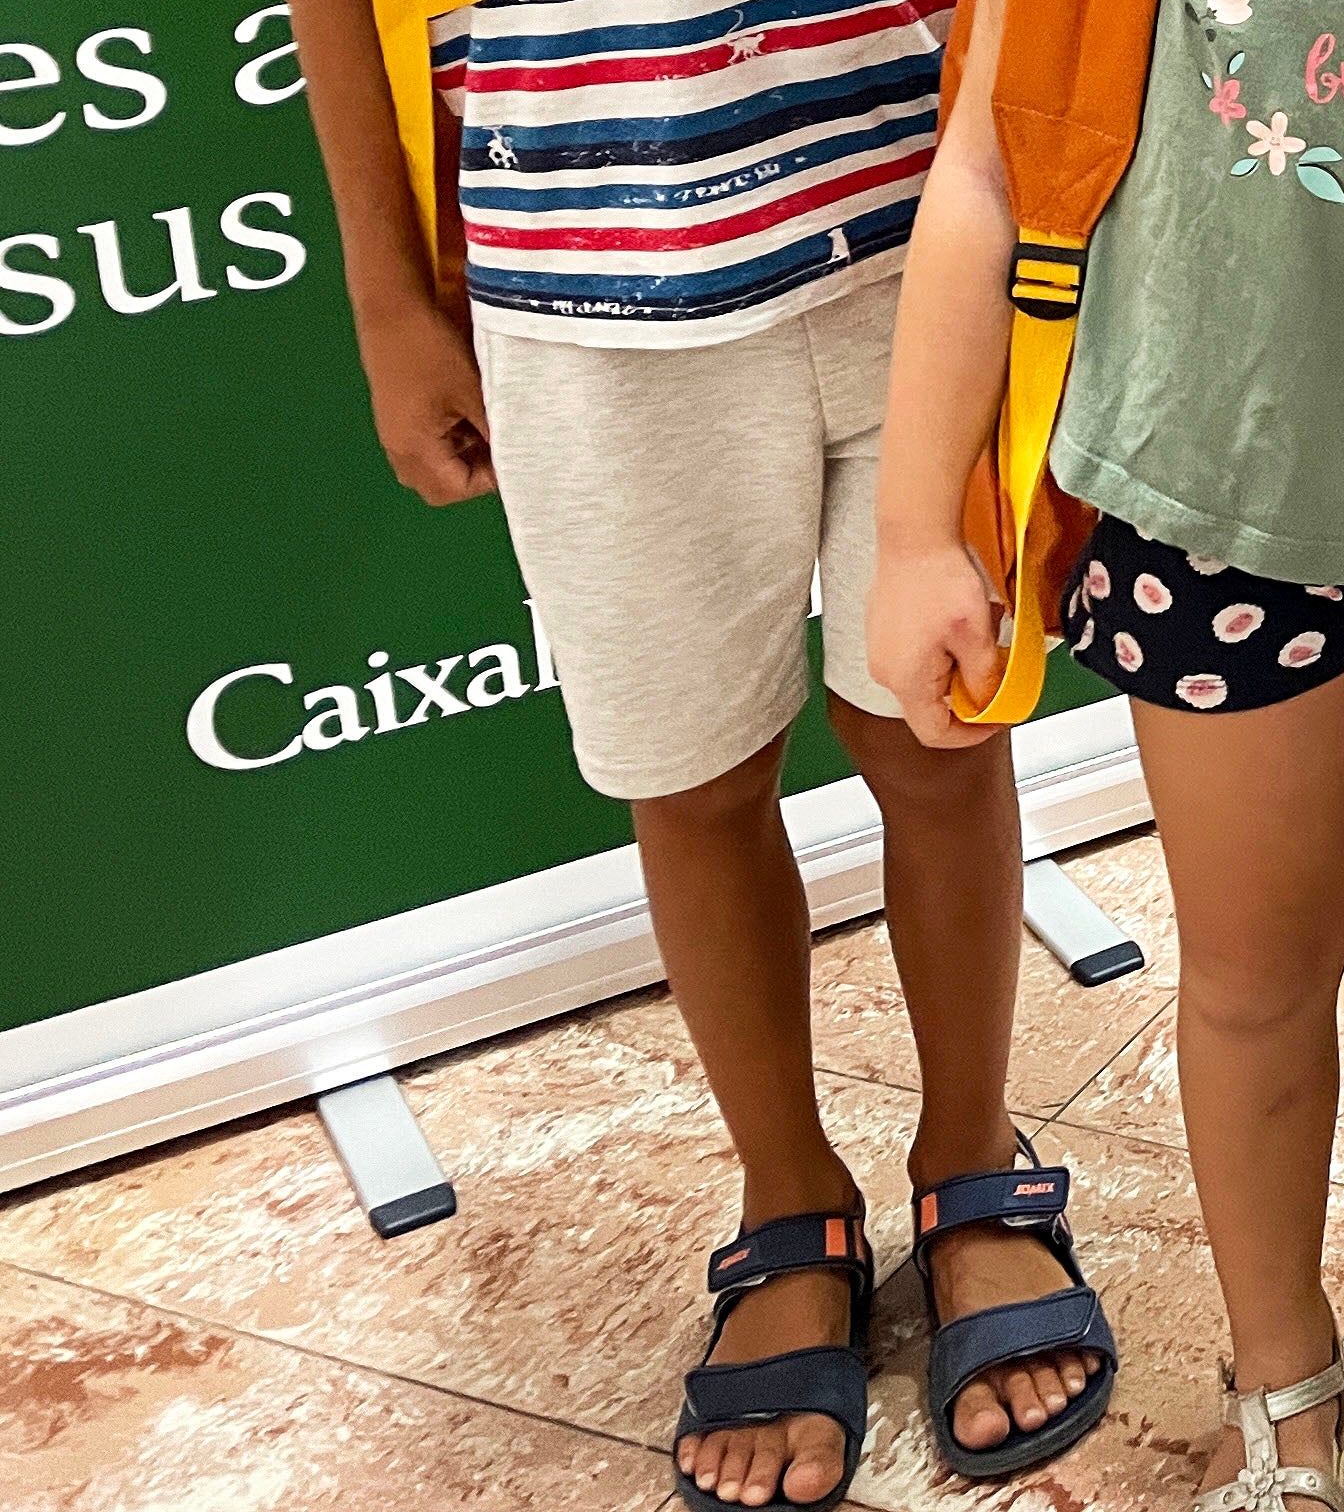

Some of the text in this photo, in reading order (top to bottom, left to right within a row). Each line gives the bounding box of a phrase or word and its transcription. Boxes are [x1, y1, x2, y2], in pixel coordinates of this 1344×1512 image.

[0, 2, 308, 146] es a
[0, 191, 308, 336] sus
